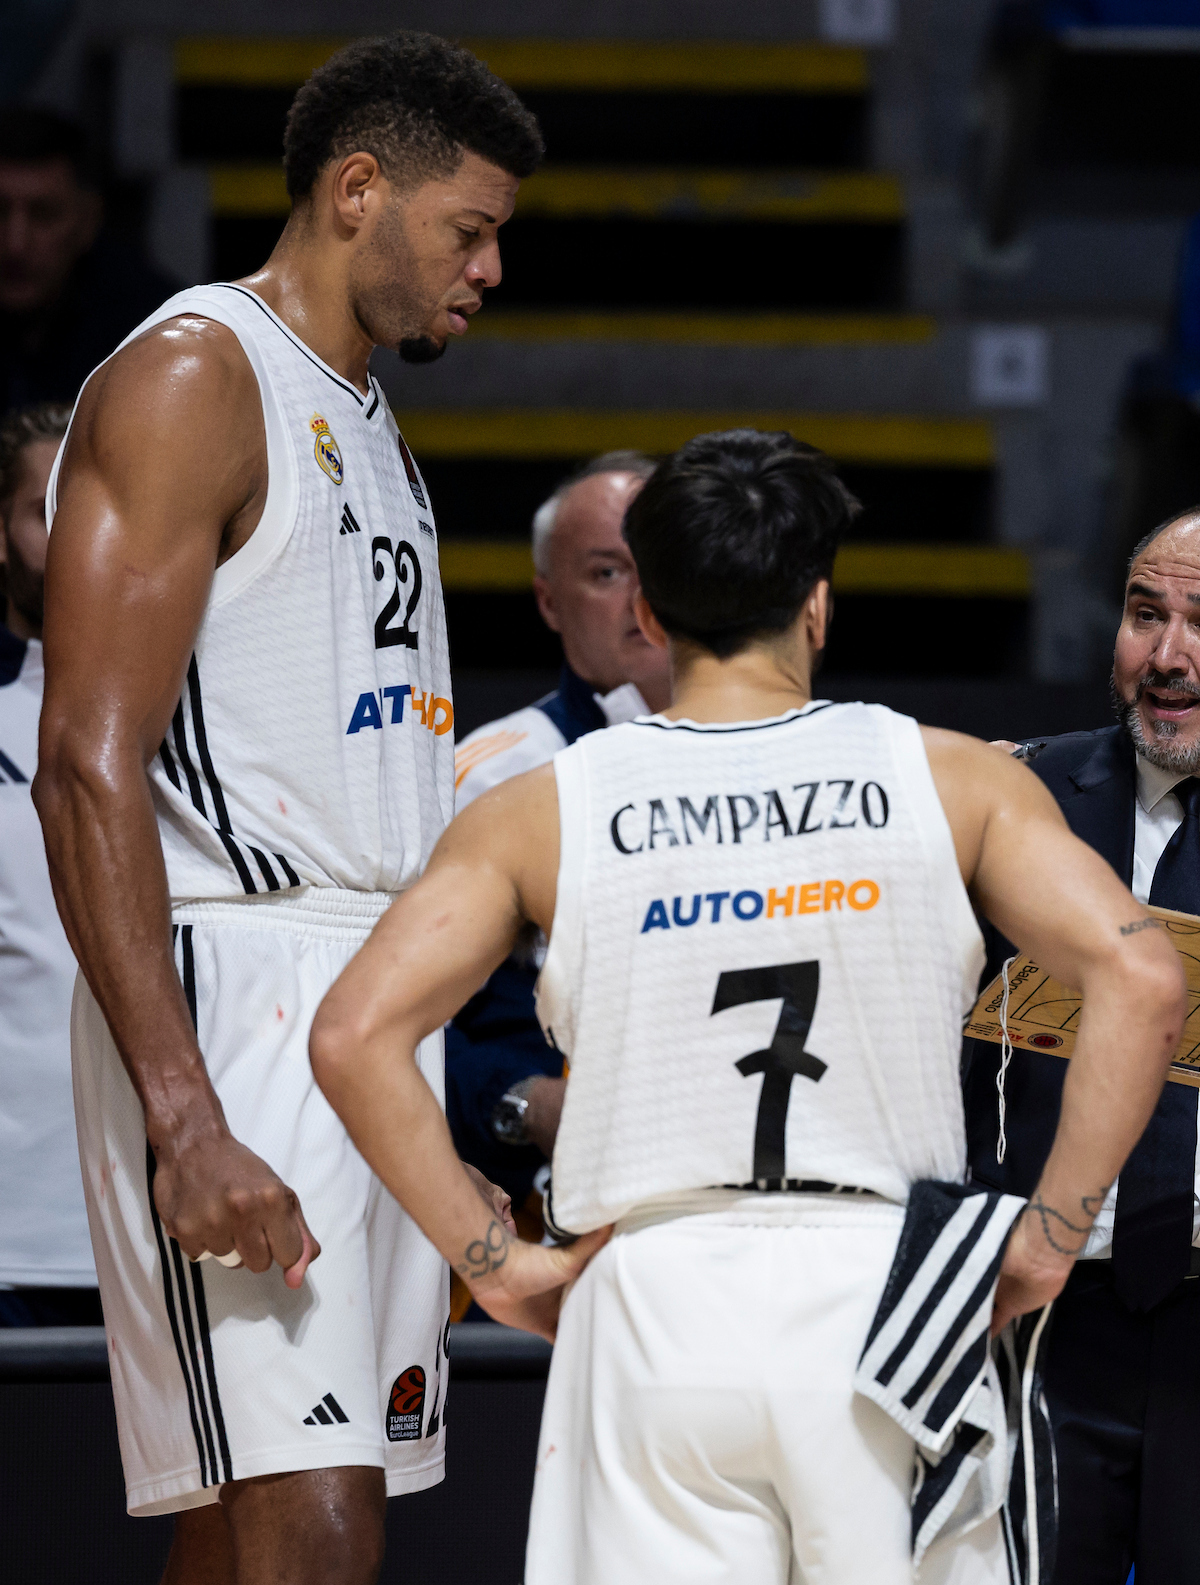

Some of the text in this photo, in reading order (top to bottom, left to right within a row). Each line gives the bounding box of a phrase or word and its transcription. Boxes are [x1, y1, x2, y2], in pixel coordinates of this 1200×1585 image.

[372, 535, 423, 650] 22
[609, 779, 890, 855] CAMPAZZO
[640, 878, 881, 934] AUTOHERO
[710, 959, 829, 1180] 7
[389, 1414, 421, 1424] TURKISH
[389, 1422, 420, 1432] AIRLINES
